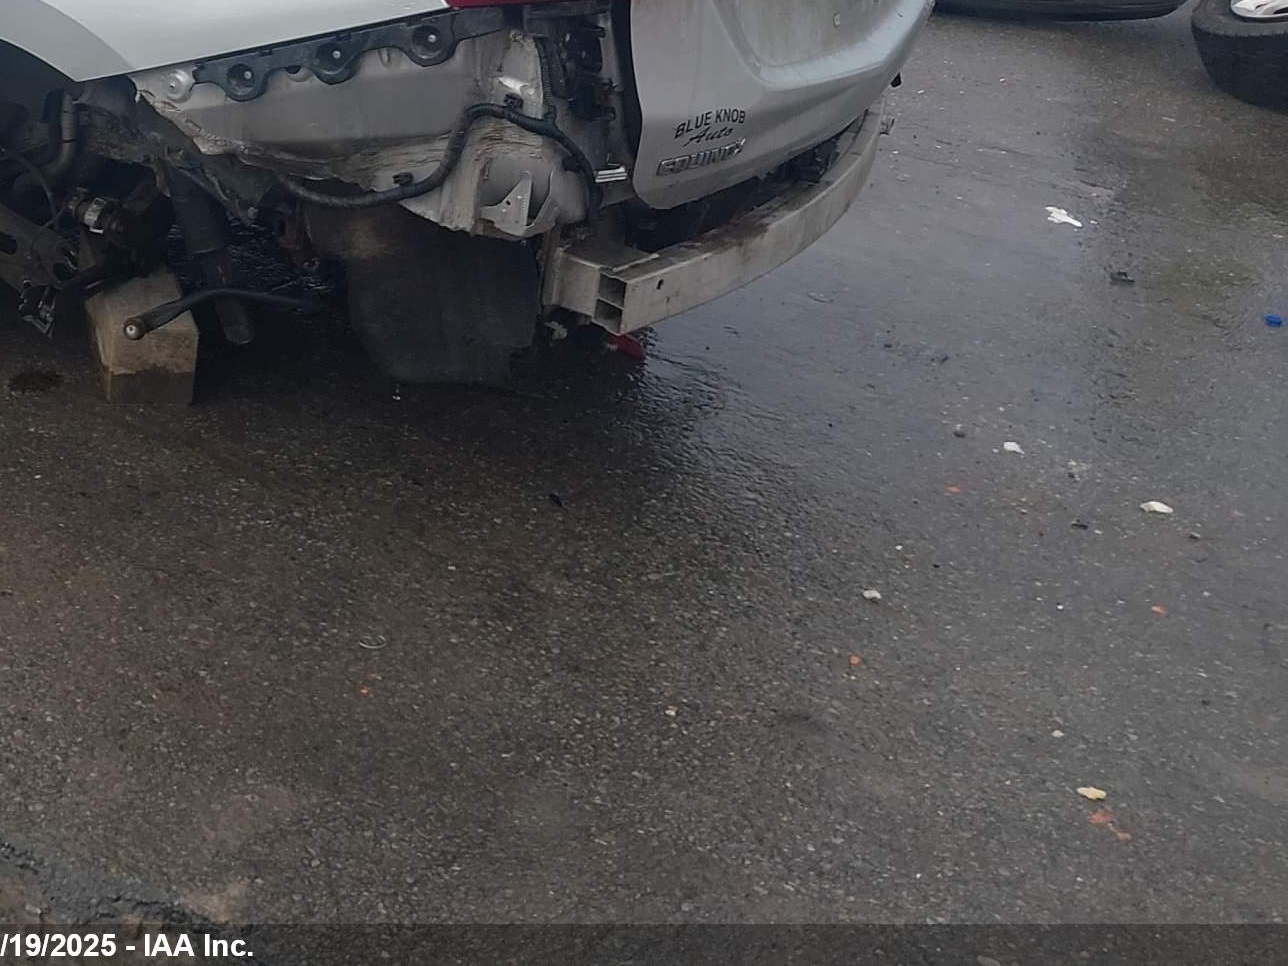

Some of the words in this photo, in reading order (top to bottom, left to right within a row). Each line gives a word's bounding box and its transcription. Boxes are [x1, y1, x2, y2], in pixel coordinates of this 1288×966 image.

[673, 111, 713, 139] BLUE
[714, 108, 747, 124] KNOB
[682, 126, 735, 148] Auto
[655, 137, 747, 177] EQUINOX
